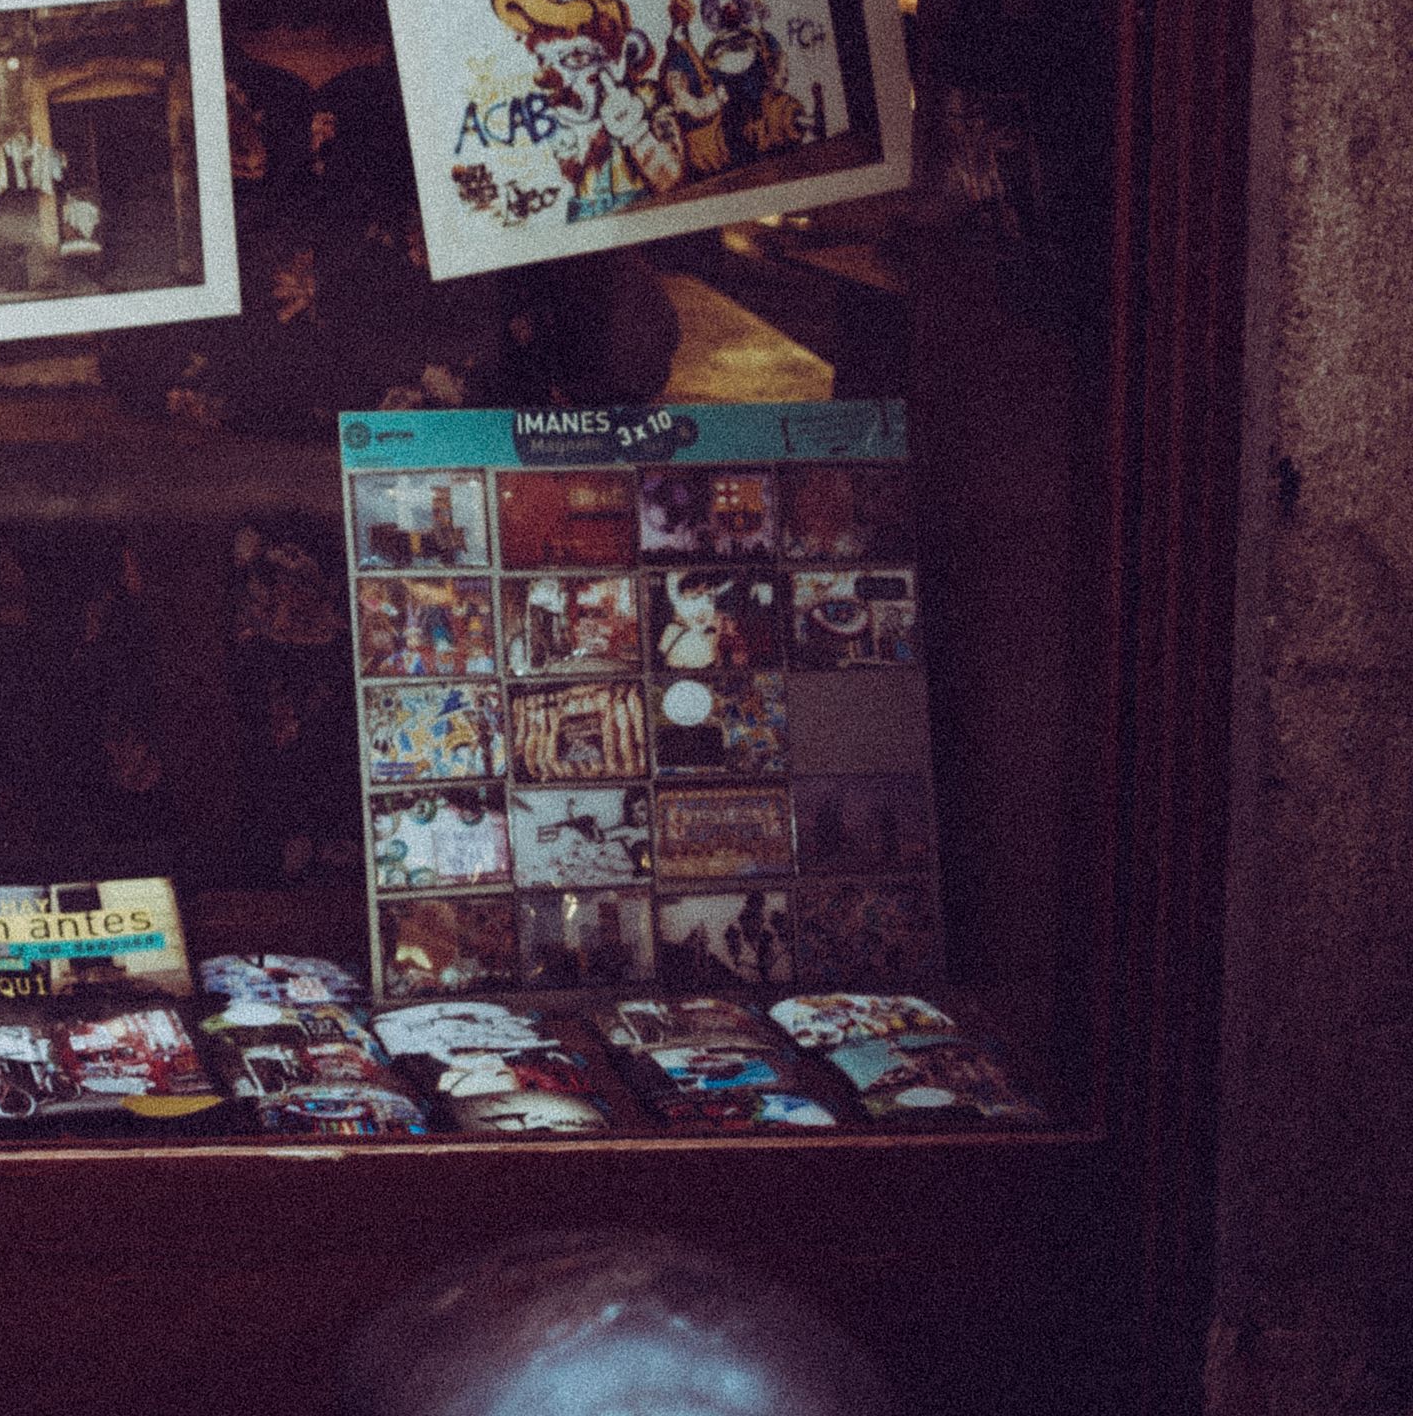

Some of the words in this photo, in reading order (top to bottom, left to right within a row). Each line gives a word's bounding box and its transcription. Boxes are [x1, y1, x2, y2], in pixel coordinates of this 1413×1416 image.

[454, 92, 559, 154] ACAB
[516, 409, 611, 436] IMANES
[616, 425, 634, 448] 3
[647, 410, 673, 435] 10
[28, 909, 154, 940] antes
